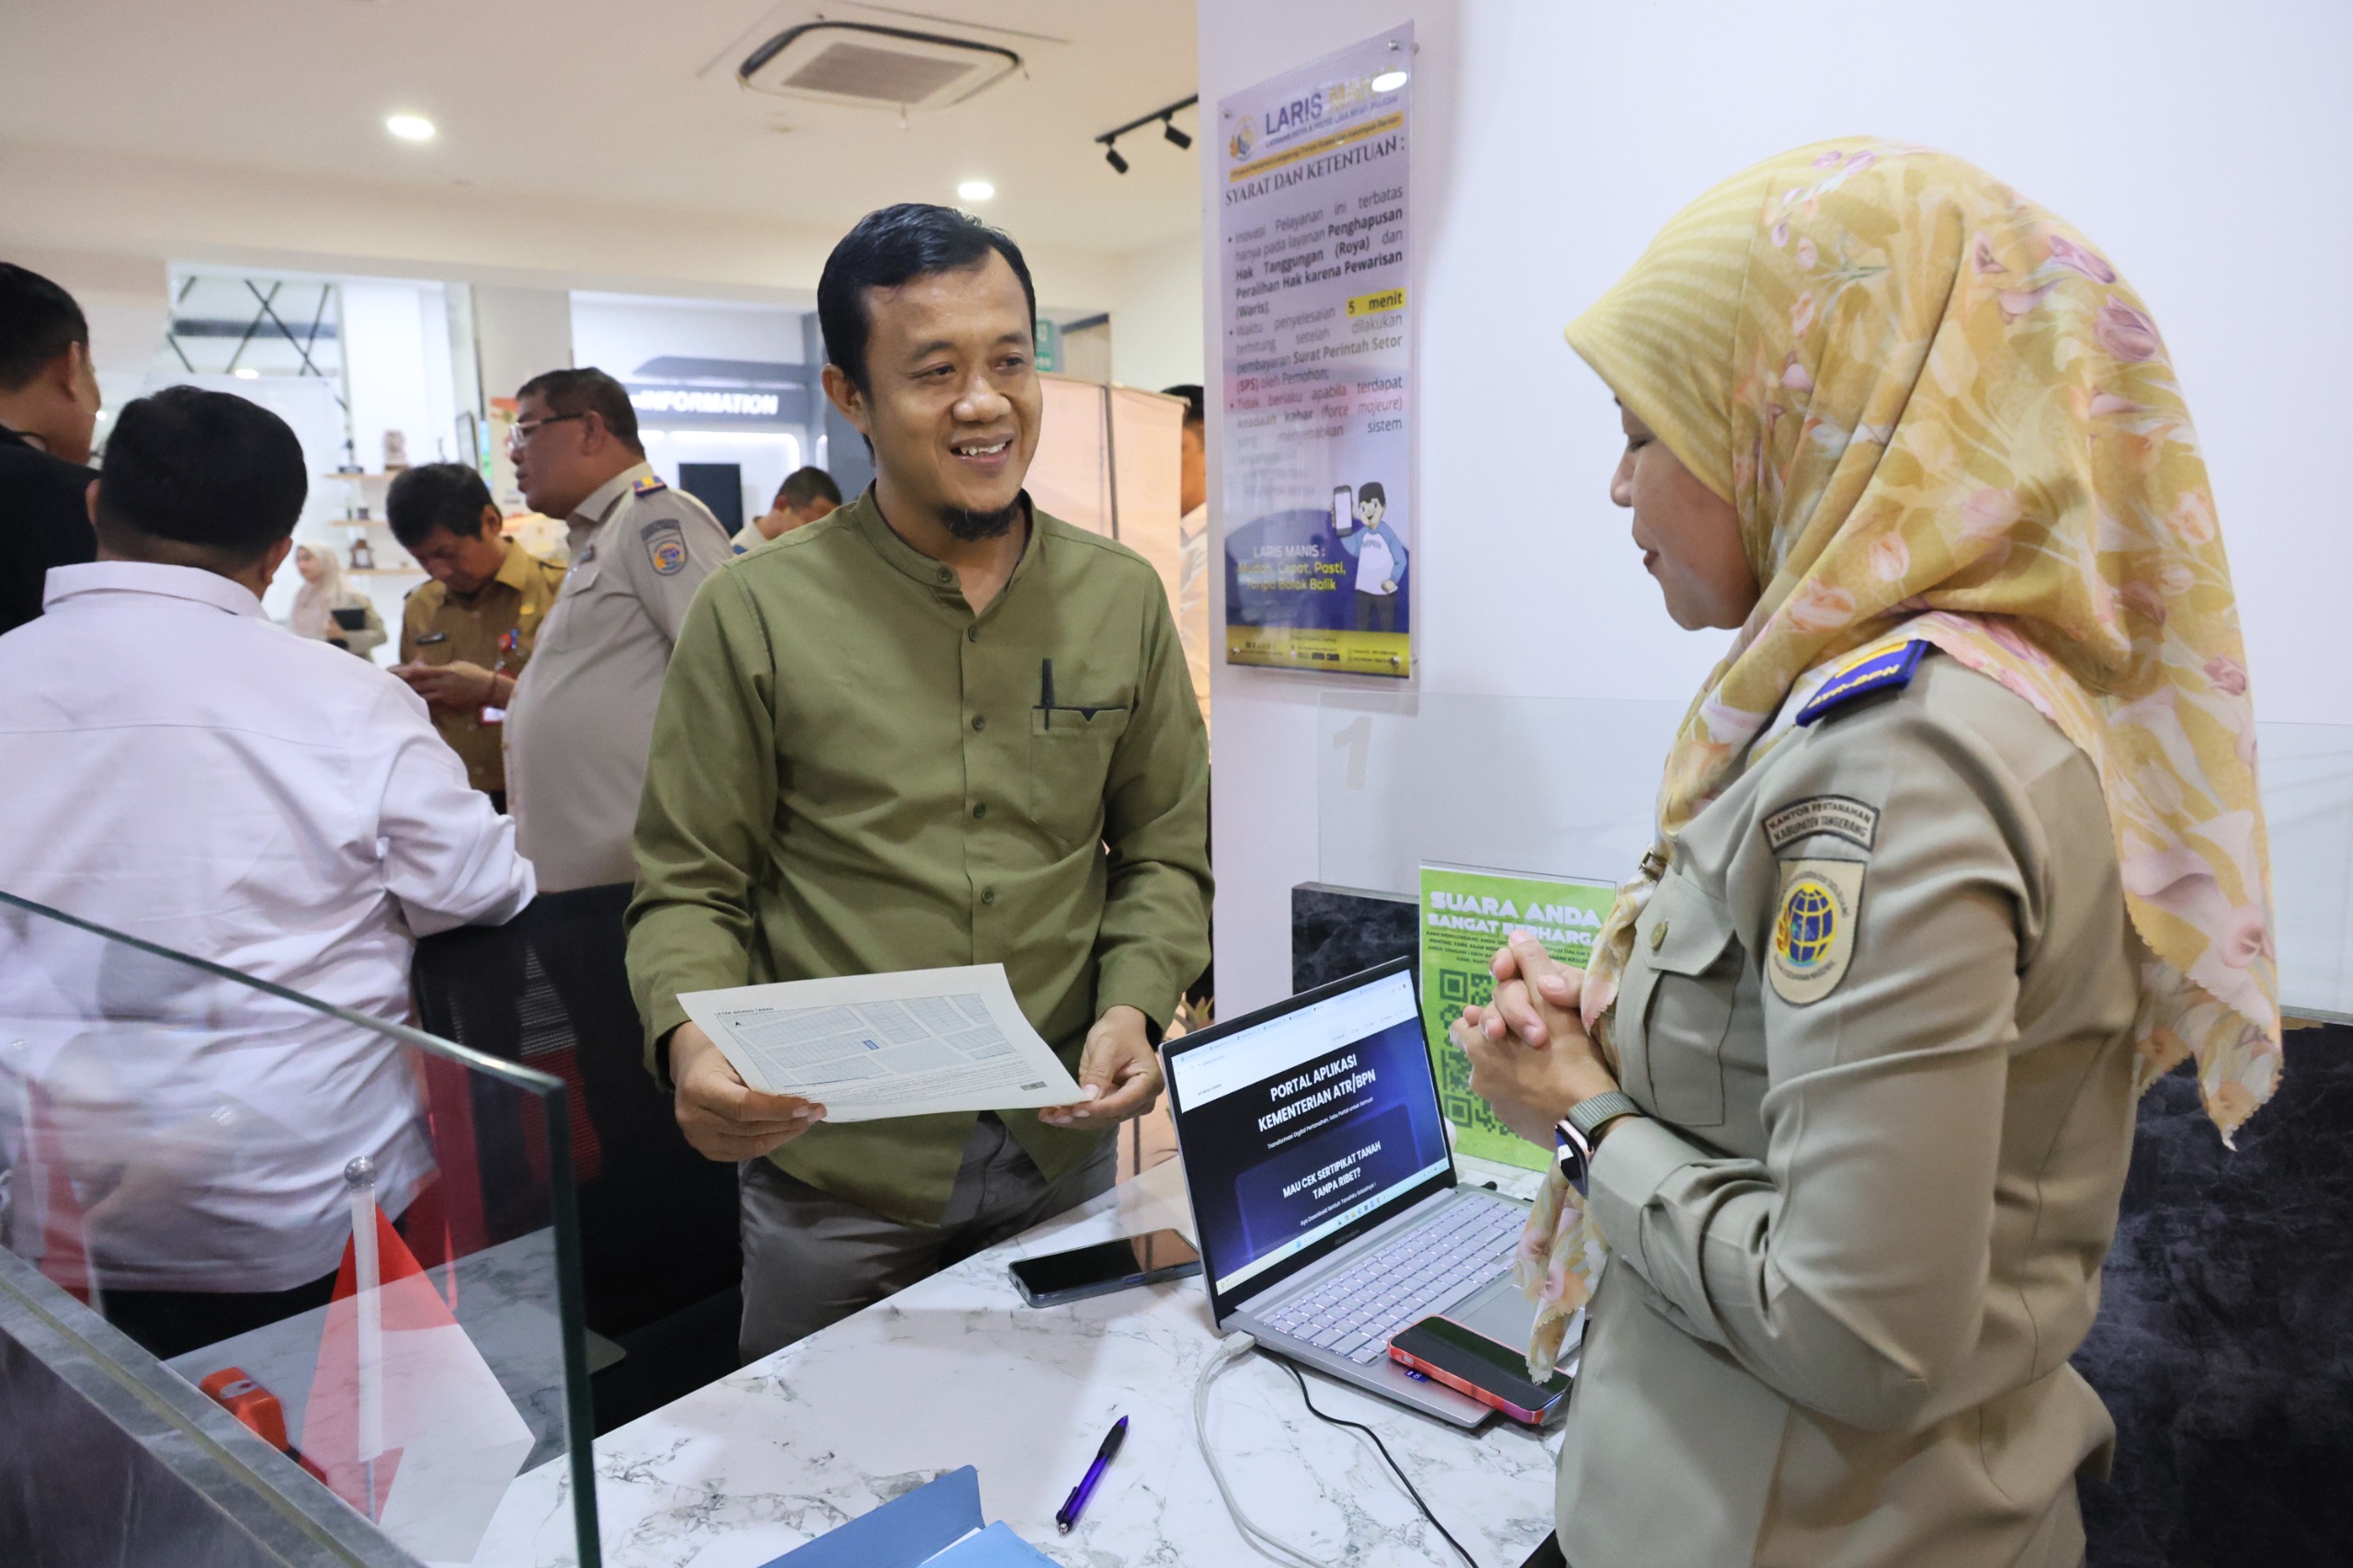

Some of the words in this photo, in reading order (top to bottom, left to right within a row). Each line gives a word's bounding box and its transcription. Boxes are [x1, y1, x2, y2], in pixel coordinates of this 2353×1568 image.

[1266, 92, 1323, 136] LARIS
[1225, 176, 1271, 207] SYARAT
[1274, 166, 1303, 191] DAN
[1307, 135, 1397, 180] KETENTUAN
[1276, 210, 1324, 232] Pelayanan
[1335, 201, 1347, 215] ini
[1358, 187, 1403, 210] terbatas
[1264, 240, 1286, 256] pada
[1288, 229, 1325, 250] layanan
[1328, 208, 1403, 237] Penghapusan
[1235, 267, 1253, 281] Hak
[1264, 250, 1324, 275] Tanggungan
[1335, 237, 1370, 258] (Roya)
[1381, 230, 1403, 244] dan
[1236, 280, 1279, 300] Peralihan
[1283, 276, 1302, 290] Hak
[1305, 265, 1341, 284] karena
[1345, 251, 1403, 274] Pewarisan
[1274, 307, 1336, 332] penyelesaian
[1348, 301, 1355, 314] 5
[1369, 292, 1403, 311] menit
[1295, 327, 1330, 346] setelah
[1351, 314, 1403, 335] dilakukan
[1236, 354, 1290, 375] pembayaran
[1293, 348, 1320, 365] Surat
[1324, 338, 1369, 359] Perintah
[1372, 335, 1403, 351] Setor
[641, 390, 779, 415] INFORMATION
[1236, 378, 1259, 394] (SPS)
[1261, 375, 1279, 387] oleh
[1237, 397, 1259, 410] Tidak
[1268, 392, 1302, 407] berlaku
[1312, 384, 1347, 402] apabila
[1357, 376, 1403, 395] terdapat
[1237, 415, 1277, 428] keadaan
[1285, 408, 1313, 422] kahar
[1322, 404, 1349, 419] (force
[1358, 396, 1403, 417] majeure)
[1278, 426, 1344, 444] menyebabkan
[1368, 418, 1403, 433] sistem
[1253, 545, 1282, 558] LARIS
[1285, 544, 1319, 558] MANIS
[1314, 562, 1346, 575] Pasti,
[1279, 577, 1306, 590] Bolak
[1310, 577, 1336, 590] Balik
[1332, 716, 1372, 790] 1
[1768, 805, 1810, 830] KANTOR
[1427, 913, 1499, 934] SANGAT
[1430, 891, 1520, 919] SUARA
[1524, 902, 1603, 929] ANDA
[1270, 1073, 1313, 1102] PORTAL
[1313, 1053, 1358, 1084] APLIKASI
[1257, 1087, 1333, 1132] KEMENTERIAN
[1333, 1068, 1376, 1099] ATR/BPN
[1282, 1181, 1302, 1198] MAU
[1302, 1173, 1317, 1187] CEK
[1317, 1153, 1356, 1181] SERTIPIKAT
[1357, 1141, 1381, 1161] TANAH
[1313, 1180, 1338, 1199] TANPA
[1338, 1166, 1361, 1187] RIBET?
